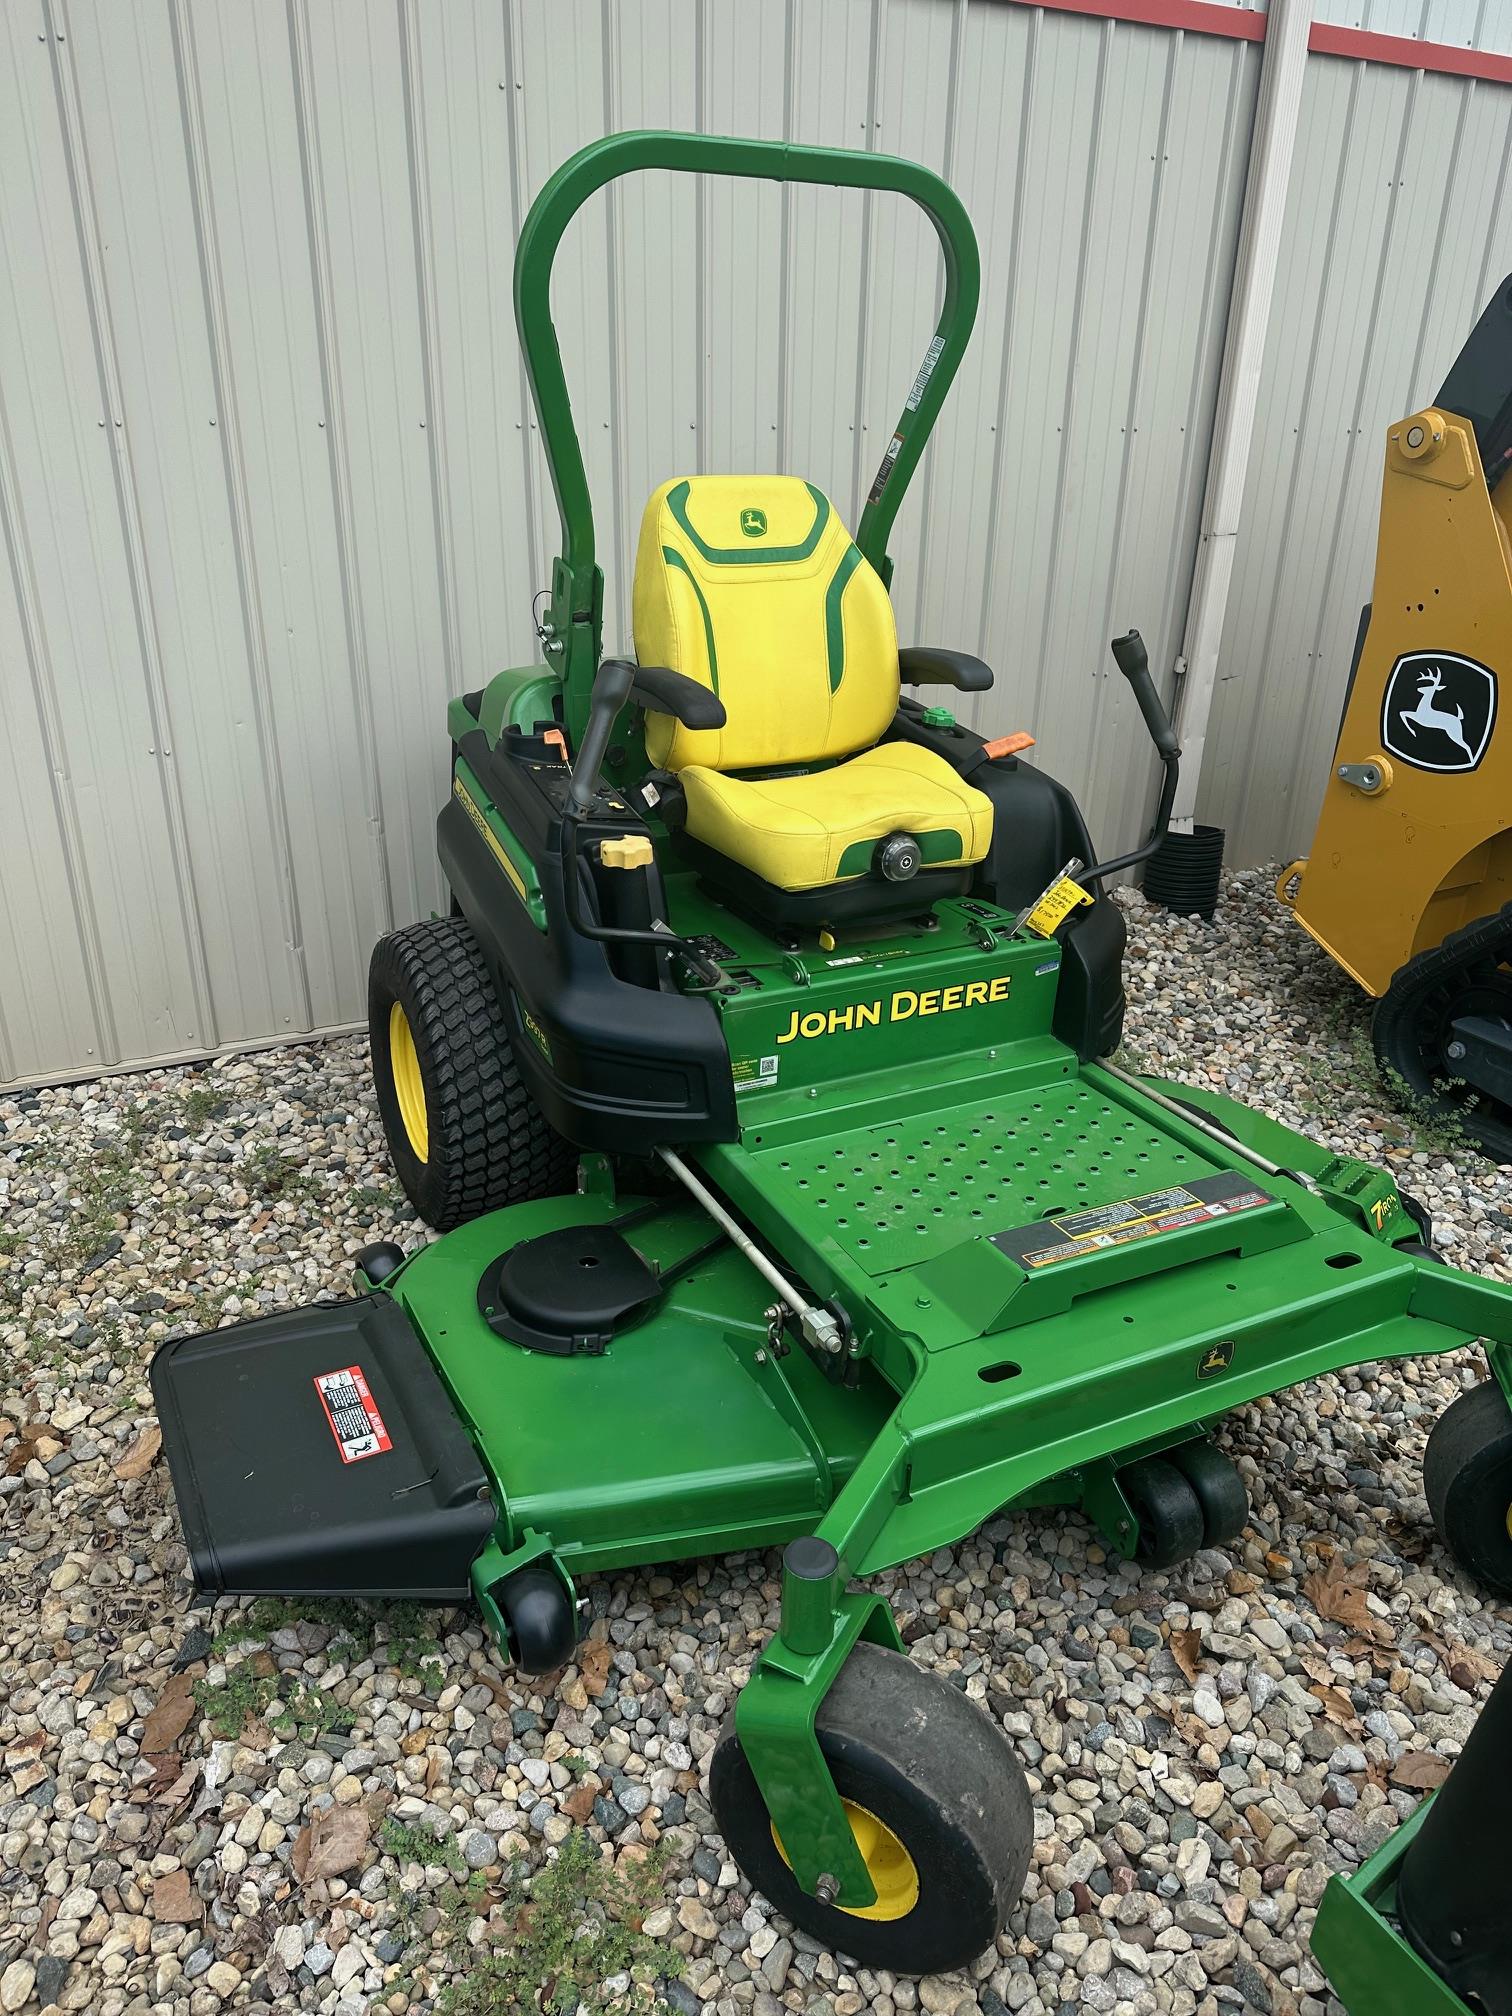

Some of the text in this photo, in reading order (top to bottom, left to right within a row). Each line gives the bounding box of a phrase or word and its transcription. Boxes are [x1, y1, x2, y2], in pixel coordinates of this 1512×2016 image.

[776, 976, 1011, 1044] JOHN DEERE
[354, 1378, 370, 1398] DANGER
[371, 1416, 387, 1439] PELIGRO
